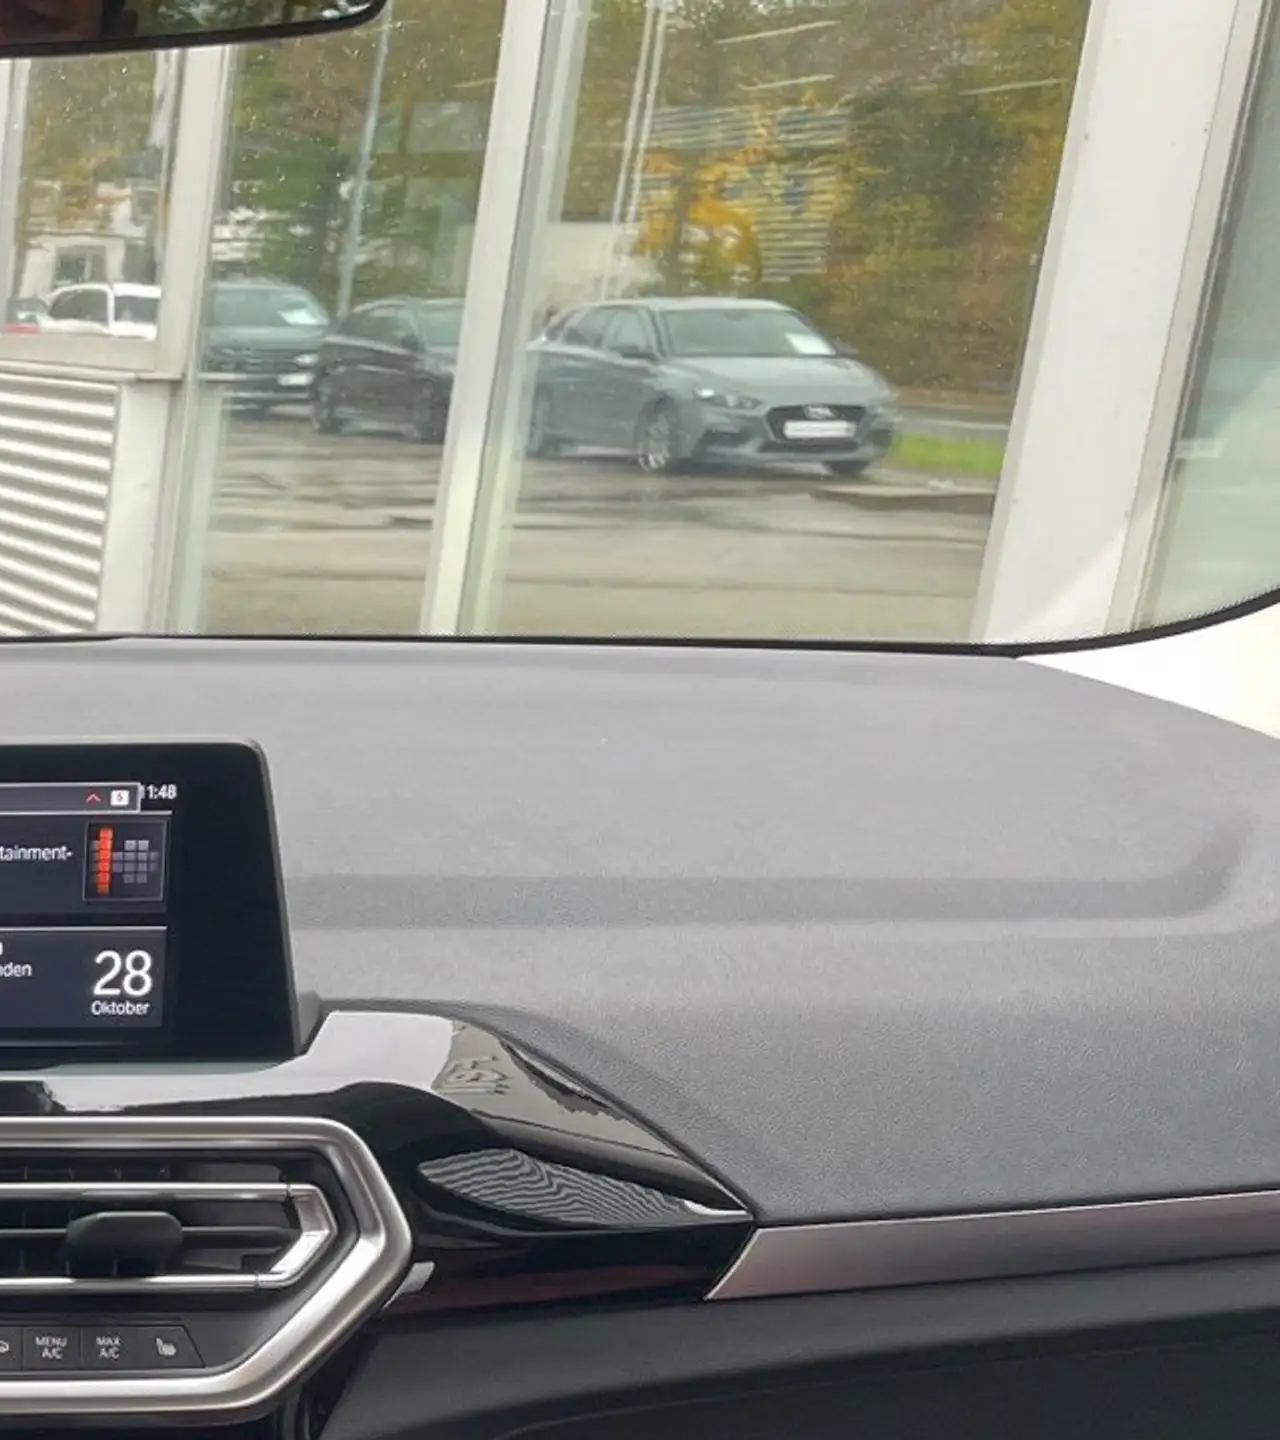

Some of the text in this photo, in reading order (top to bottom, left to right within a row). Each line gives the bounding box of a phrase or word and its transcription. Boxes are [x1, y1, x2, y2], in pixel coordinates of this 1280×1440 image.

[92, 949, 154, 997] 28
[91, 1000, 151, 1016] Oktober
[35, 1336, 68, 1347] MENU
[95, 1336, 121, 1347] MAX
